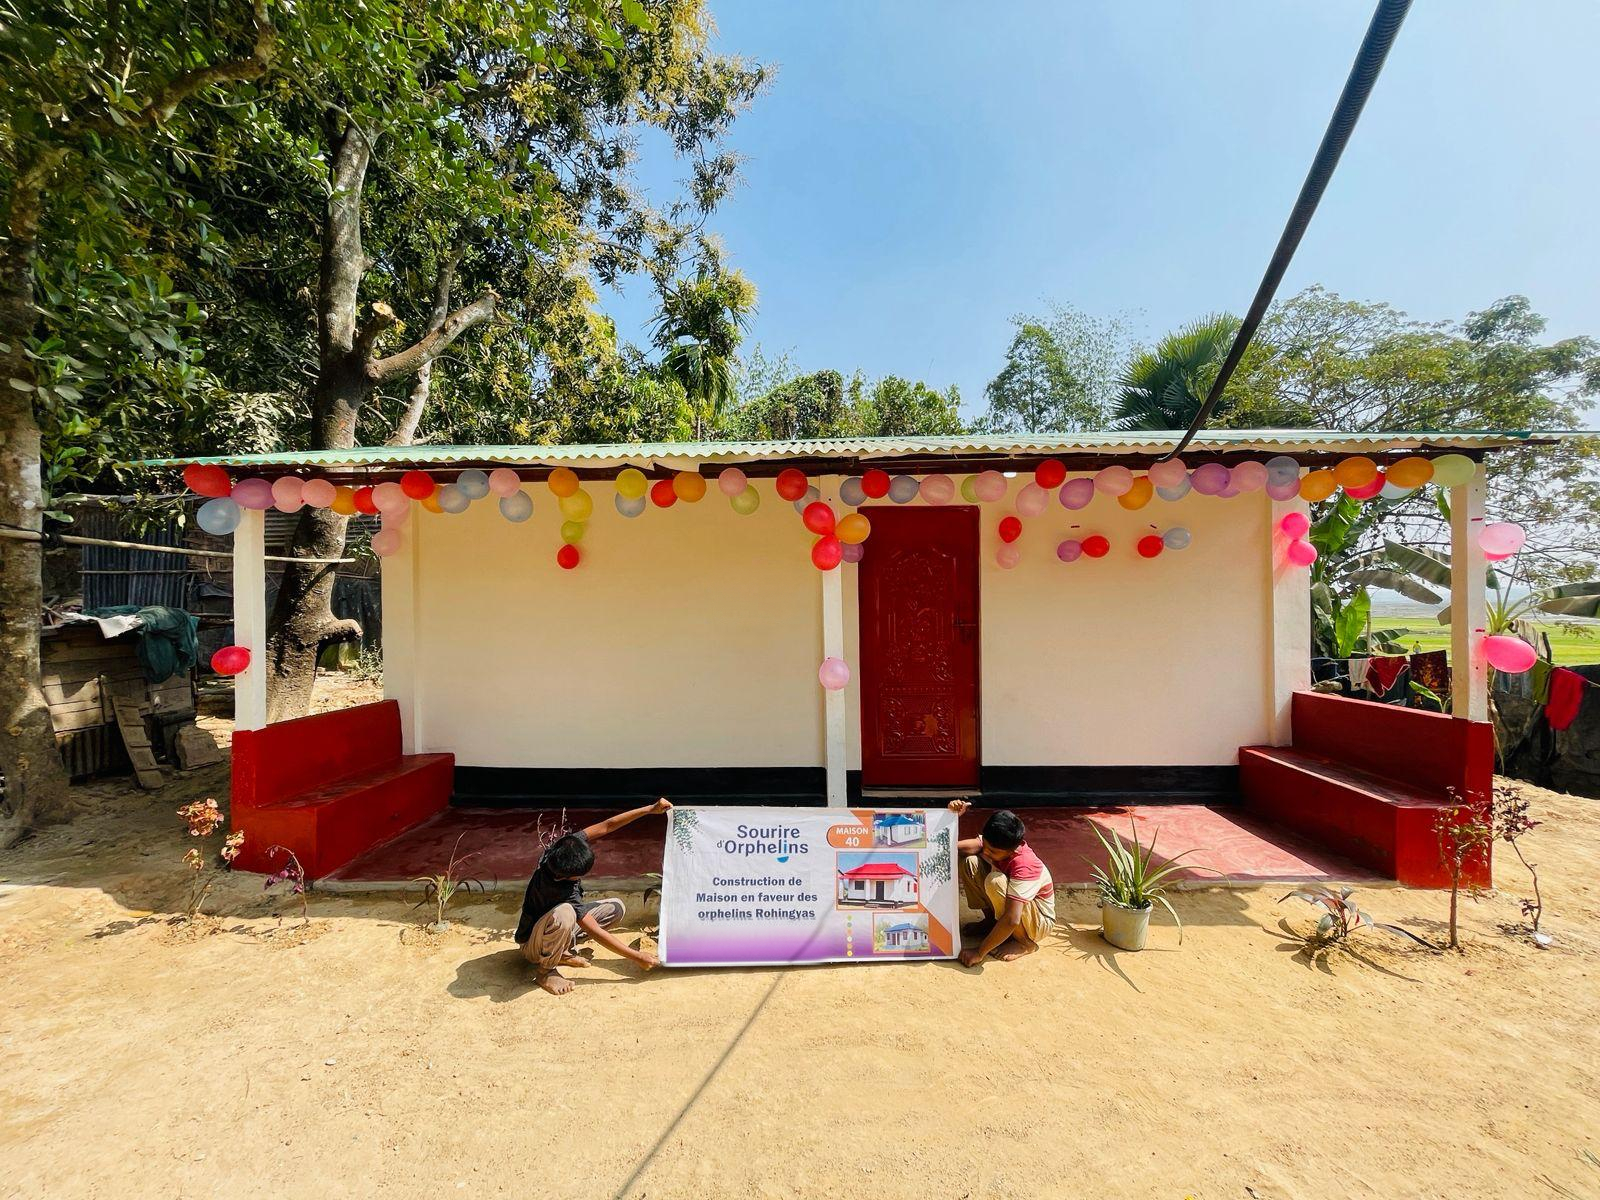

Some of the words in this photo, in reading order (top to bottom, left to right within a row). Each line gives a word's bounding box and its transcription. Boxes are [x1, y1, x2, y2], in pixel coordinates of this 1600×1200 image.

[737, 824, 800, 839] Sourire
[836, 827, 869, 836] MAISON
[845, 837, 859, 847] 40
[717, 839, 809, 857] d'Orphelins
[712, 876, 785, 886] Construction
[788, 876, 802, 886] de
[696, 892, 738, 903] Maison
[741, 894, 755, 902] en
[757, 892, 795, 902] faveur
[797, 892, 817, 902] des
[698, 908, 753, 920] orphelins
[756, 908, 815, 919] Rohingyas
